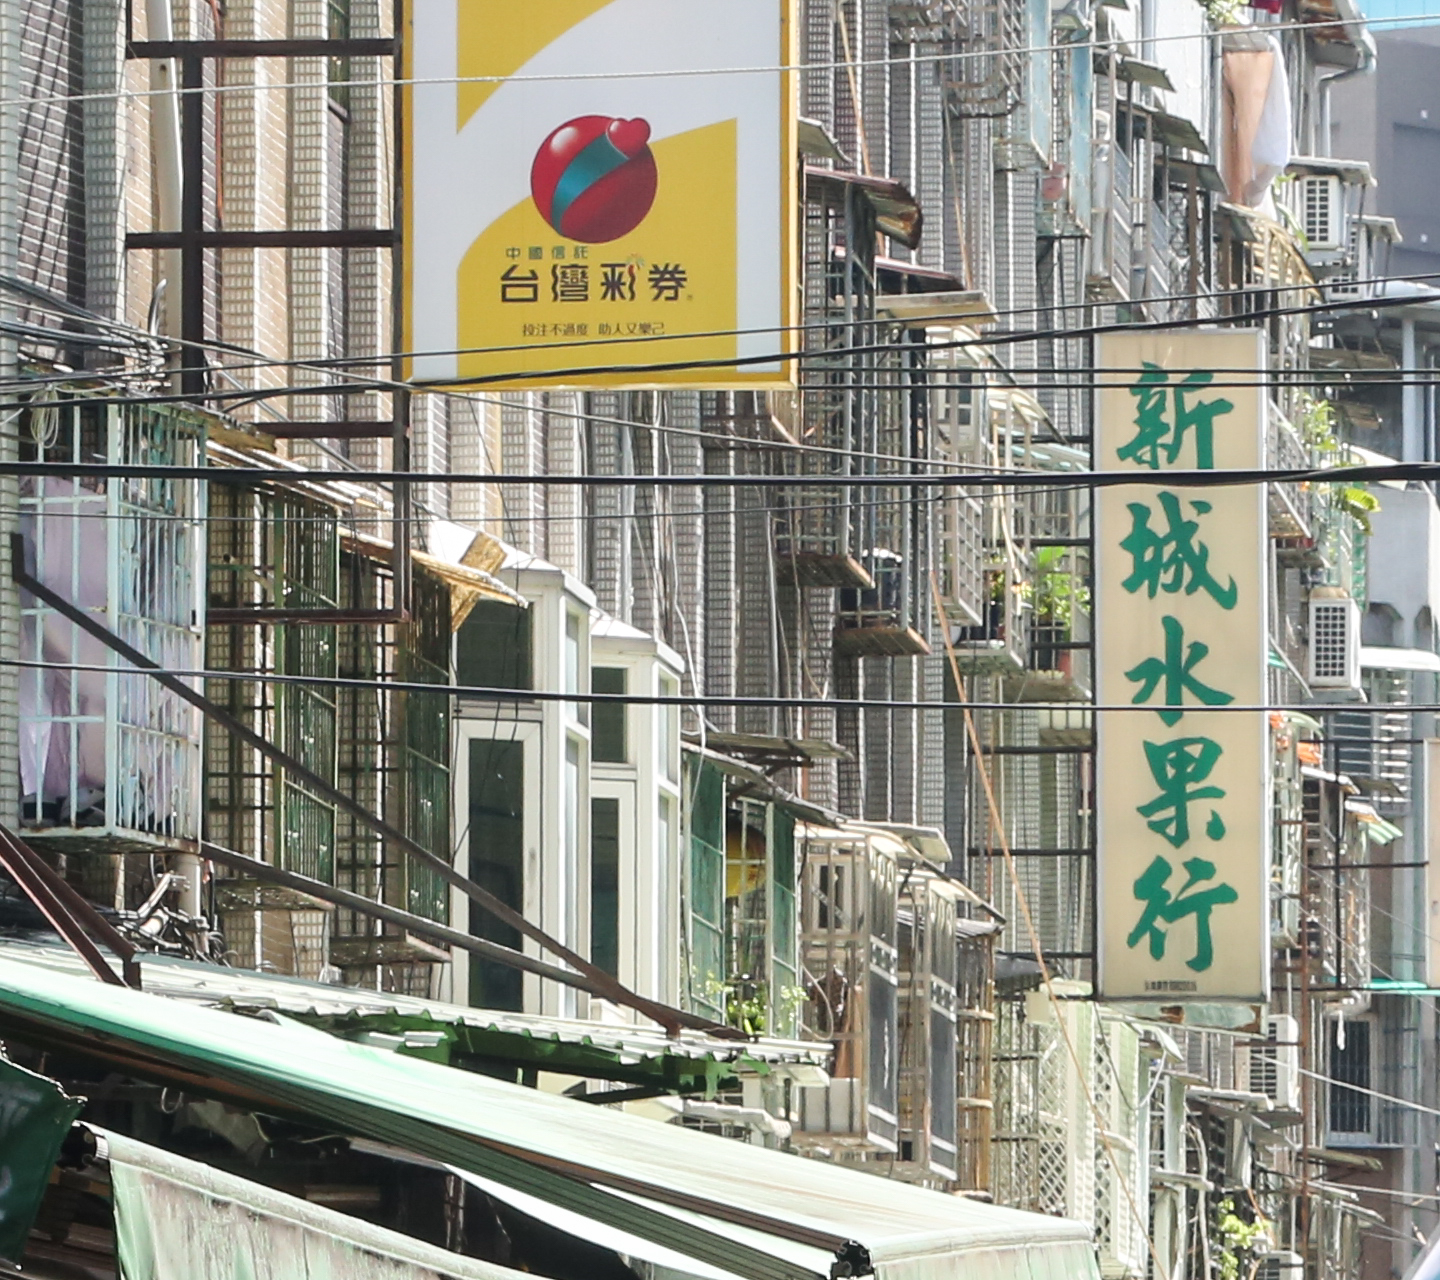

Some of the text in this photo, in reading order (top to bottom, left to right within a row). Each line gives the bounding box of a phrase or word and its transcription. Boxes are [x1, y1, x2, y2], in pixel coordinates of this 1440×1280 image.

[505, 246, 589, 260] 中國信託
[500, 261, 688, 303] 台灣彩券
[1115, 361, 1240, 973] 新城水果行
